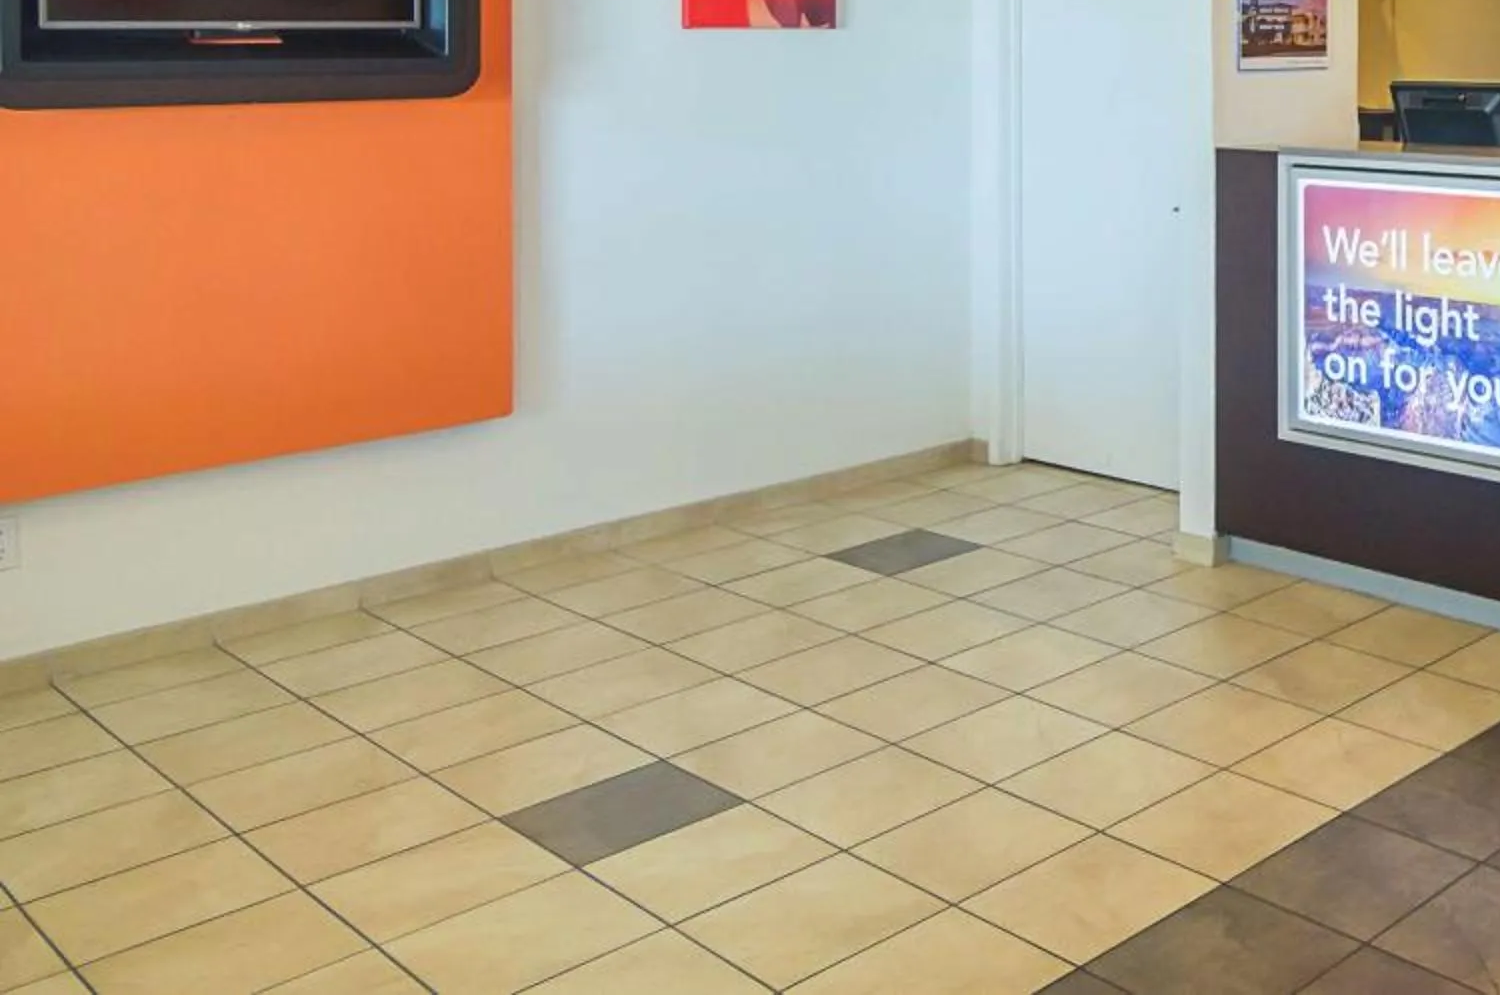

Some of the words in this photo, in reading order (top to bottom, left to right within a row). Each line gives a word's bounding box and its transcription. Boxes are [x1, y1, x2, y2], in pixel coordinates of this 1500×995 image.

[1322, 224, 1408, 271] We'll
[1323, 283, 1381, 327] the
[1395, 289, 1481, 347] light
[1324, 354, 1367, 385] on
[1380, 348, 1434, 394] for
